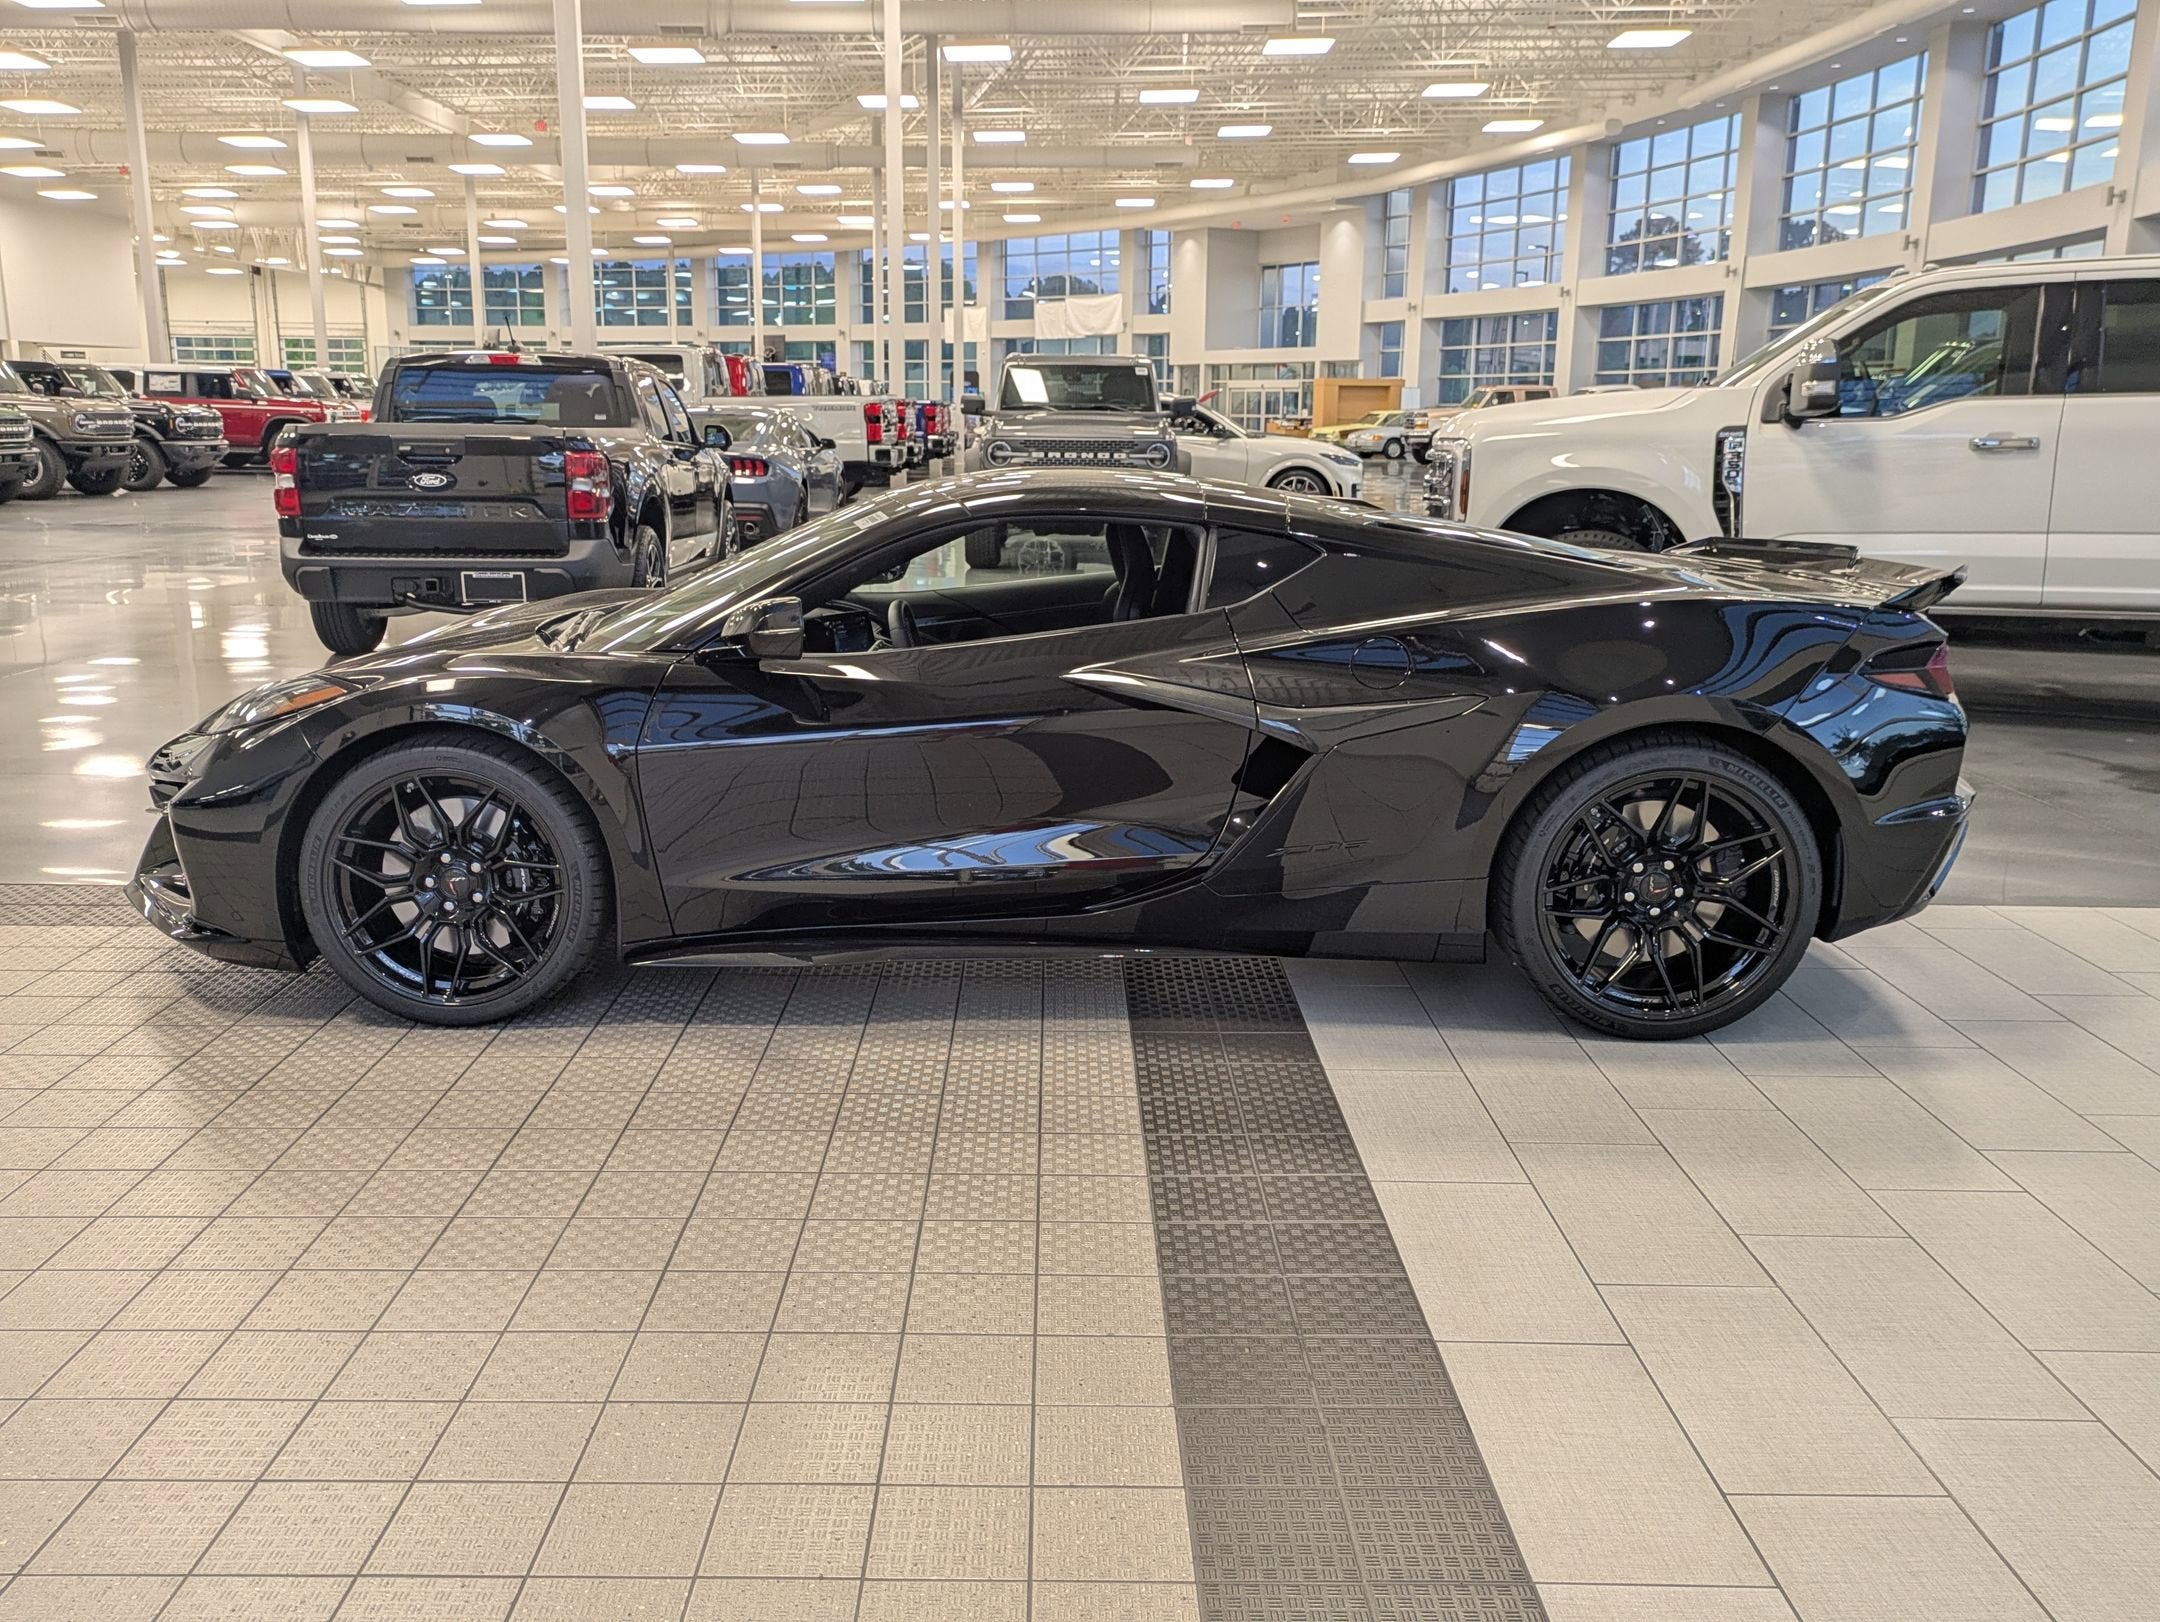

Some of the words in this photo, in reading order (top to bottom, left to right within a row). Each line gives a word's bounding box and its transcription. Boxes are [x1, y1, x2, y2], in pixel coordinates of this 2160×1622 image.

[1031, 451, 1127, 460] BRONCO
[418, 474, 443, 486] Ford
[1726, 763, 1789, 810] MICHELIN
